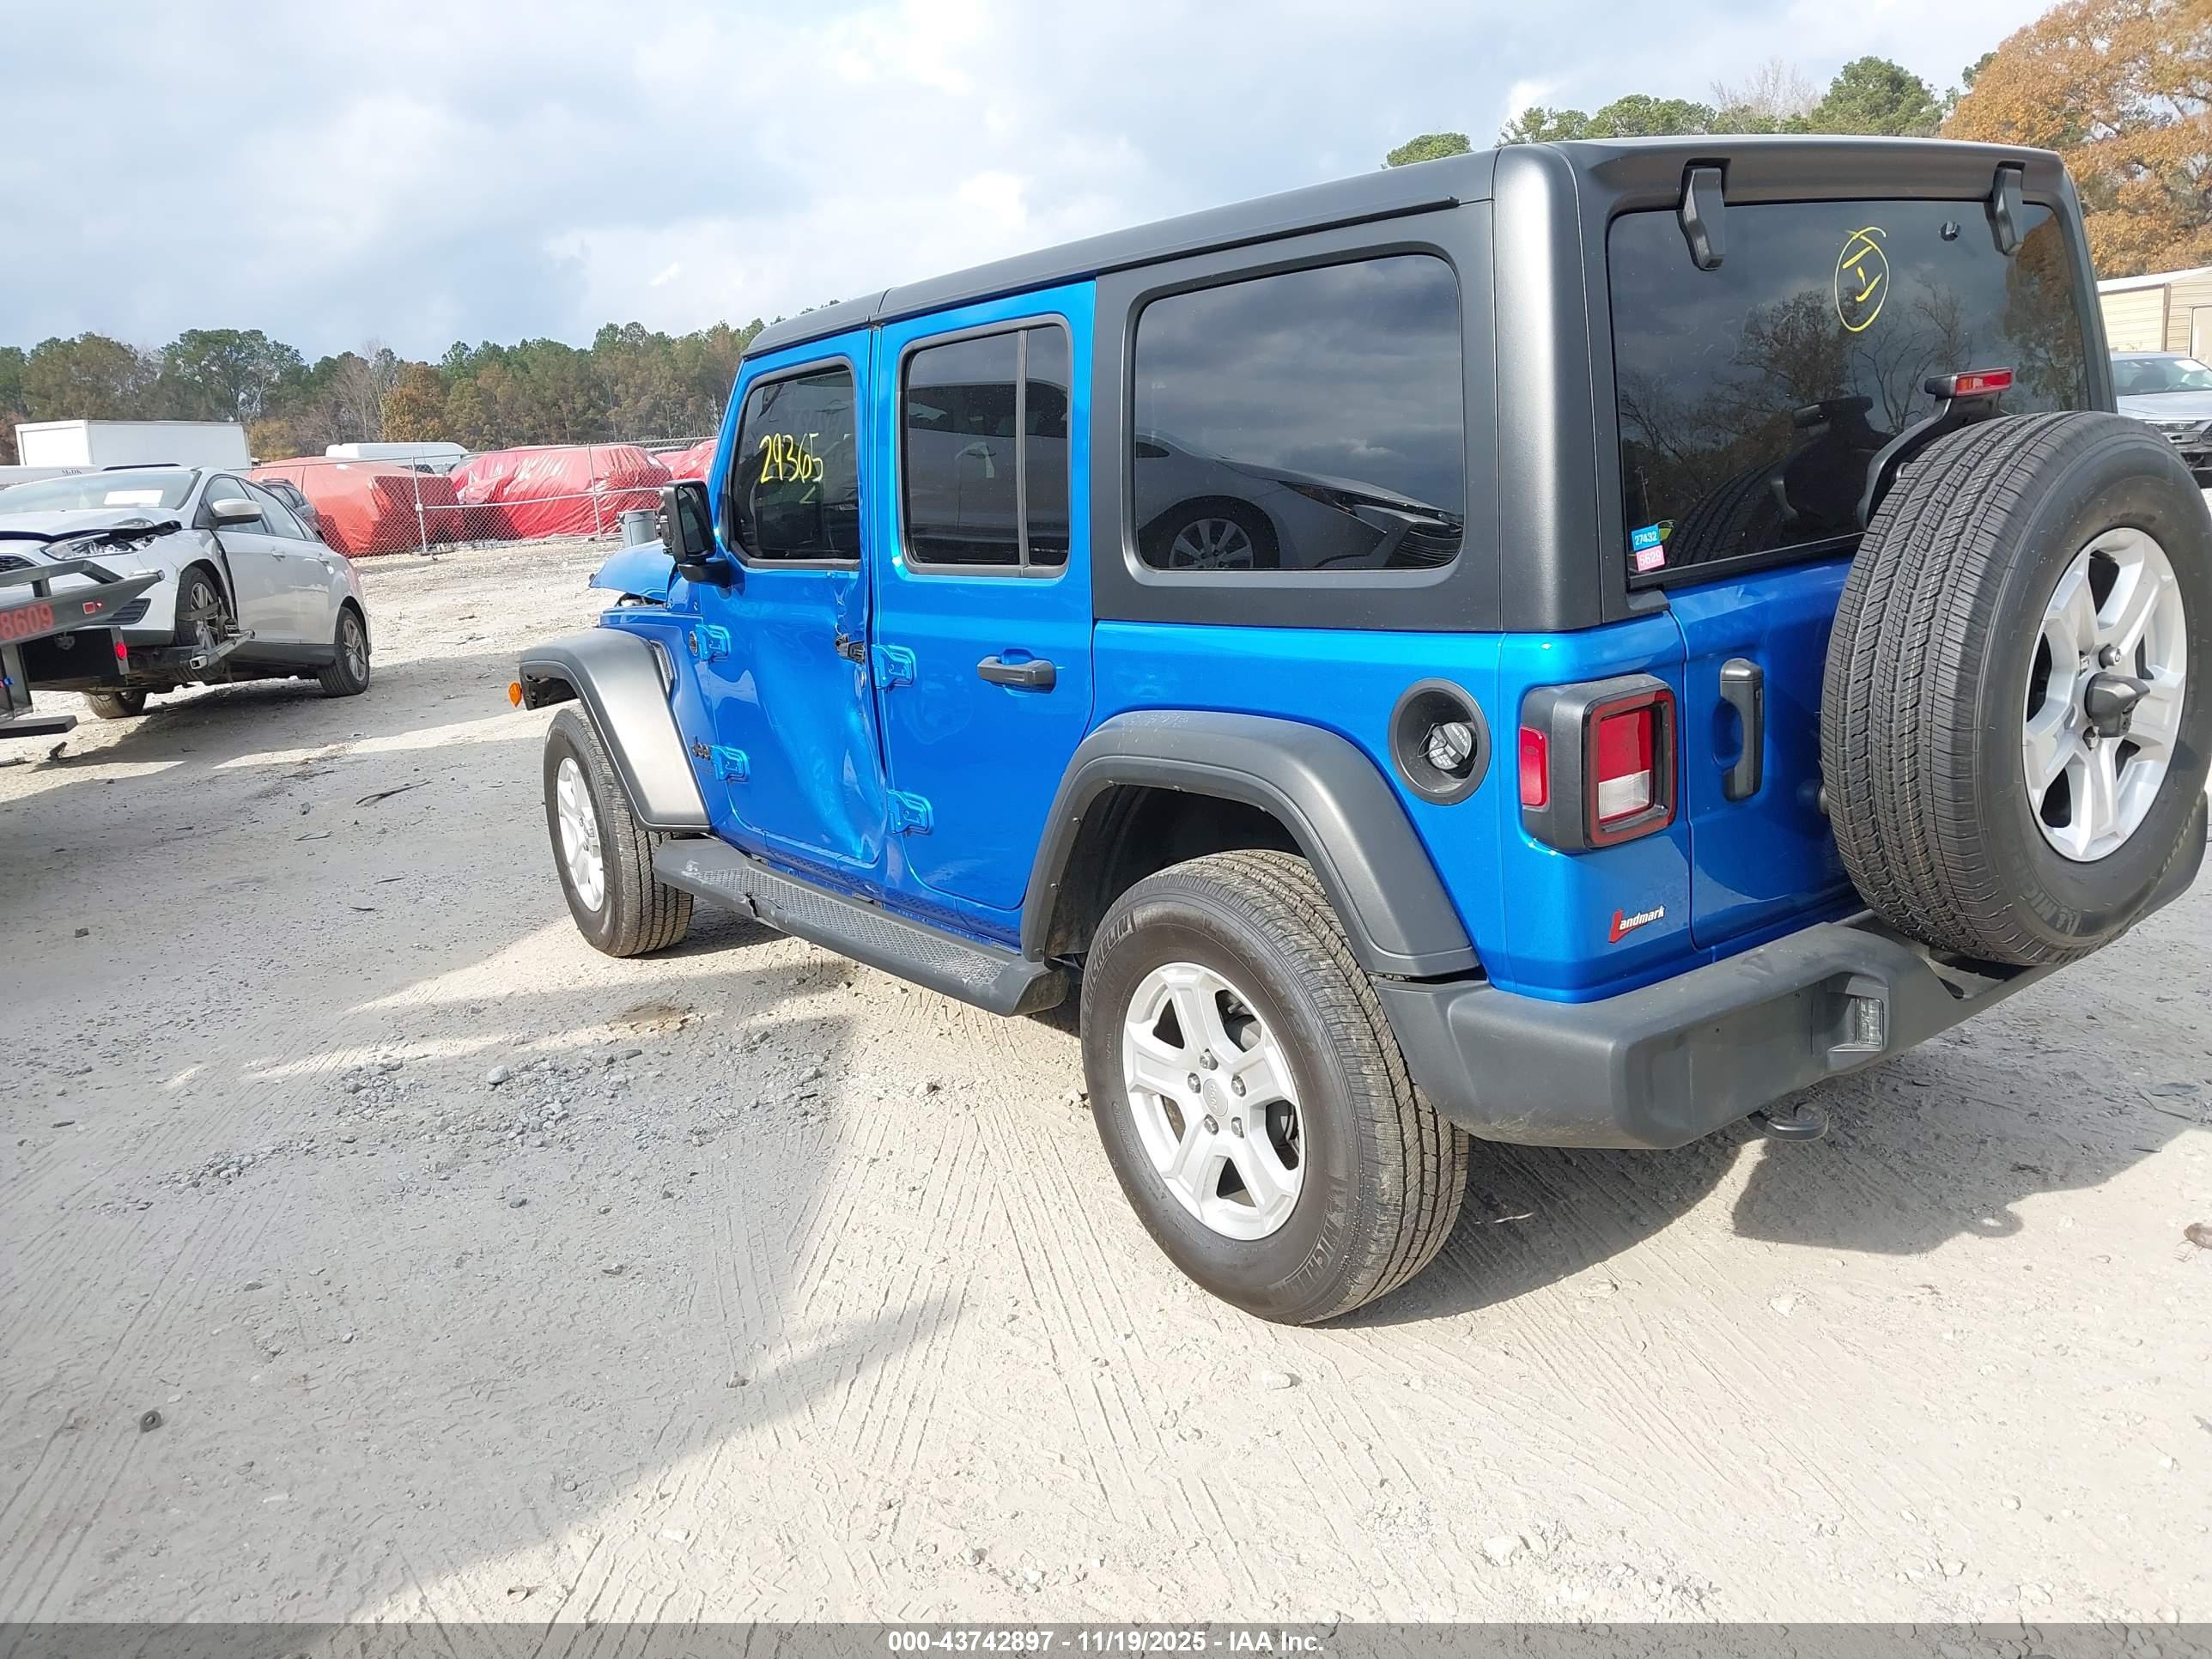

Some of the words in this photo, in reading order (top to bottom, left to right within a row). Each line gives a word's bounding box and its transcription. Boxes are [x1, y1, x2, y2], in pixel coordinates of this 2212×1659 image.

[759, 433, 823, 483] 29365
[1634, 531, 1657, 545] 27432
[0, 603, 55, 641] 8609
[1608, 904, 1665, 943] Landmark
